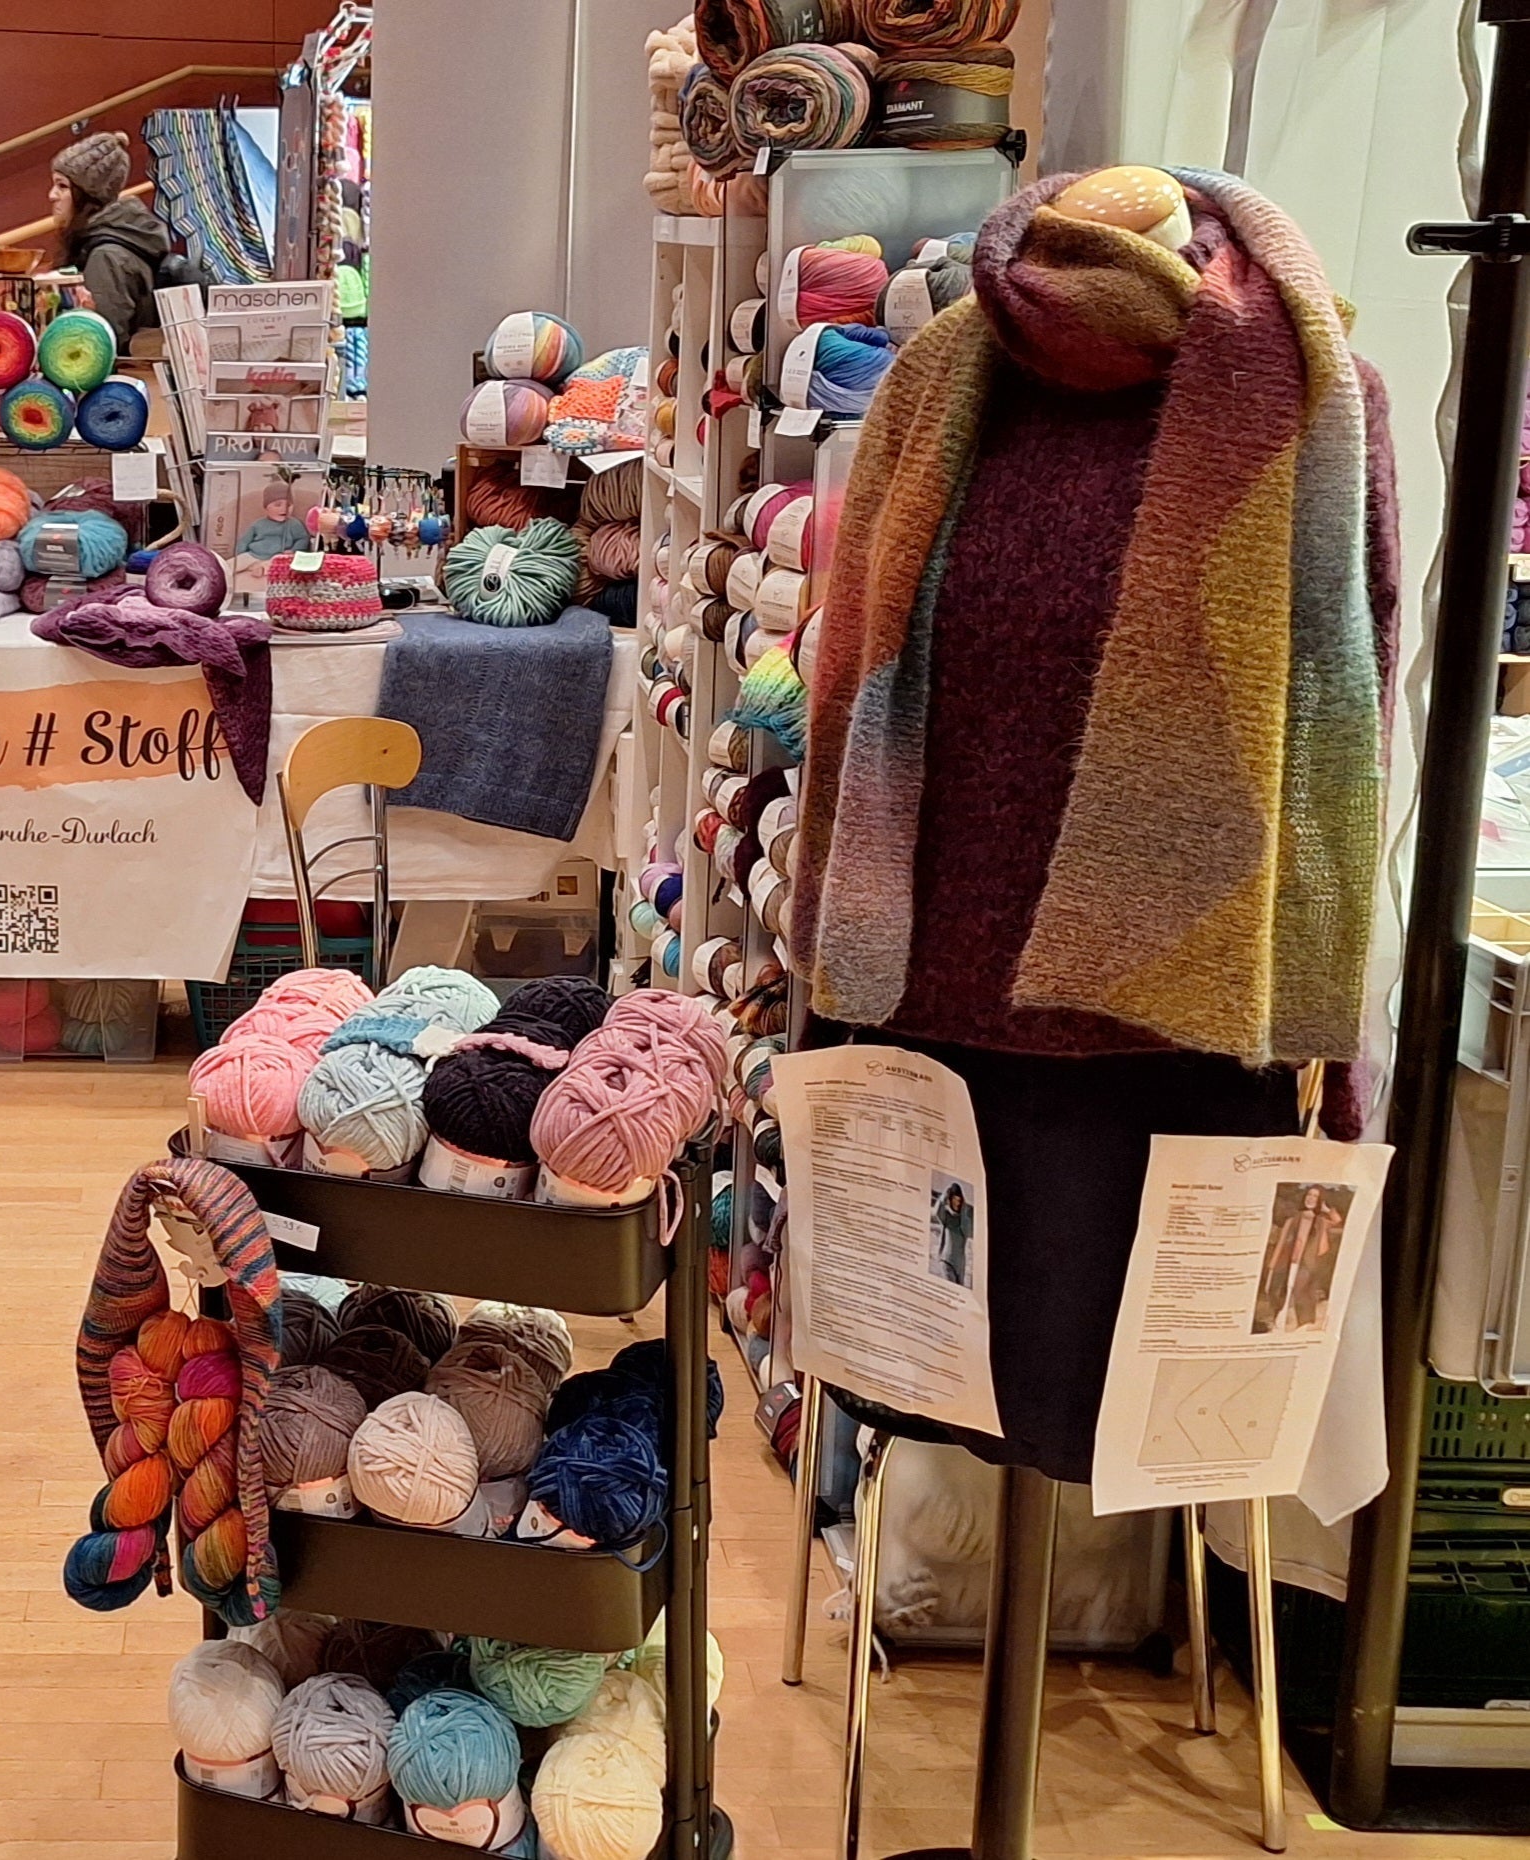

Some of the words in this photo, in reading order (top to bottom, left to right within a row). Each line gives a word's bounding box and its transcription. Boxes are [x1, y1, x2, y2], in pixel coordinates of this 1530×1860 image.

[886, 100, 925, 115] DIAMANT
[213, 289, 318, 309] maschen
[245, 366, 299, 387] katia
[214, 436, 254, 454] PRO
[22, 712, 58, 767] #
[81, 709, 231, 781] Stoff
